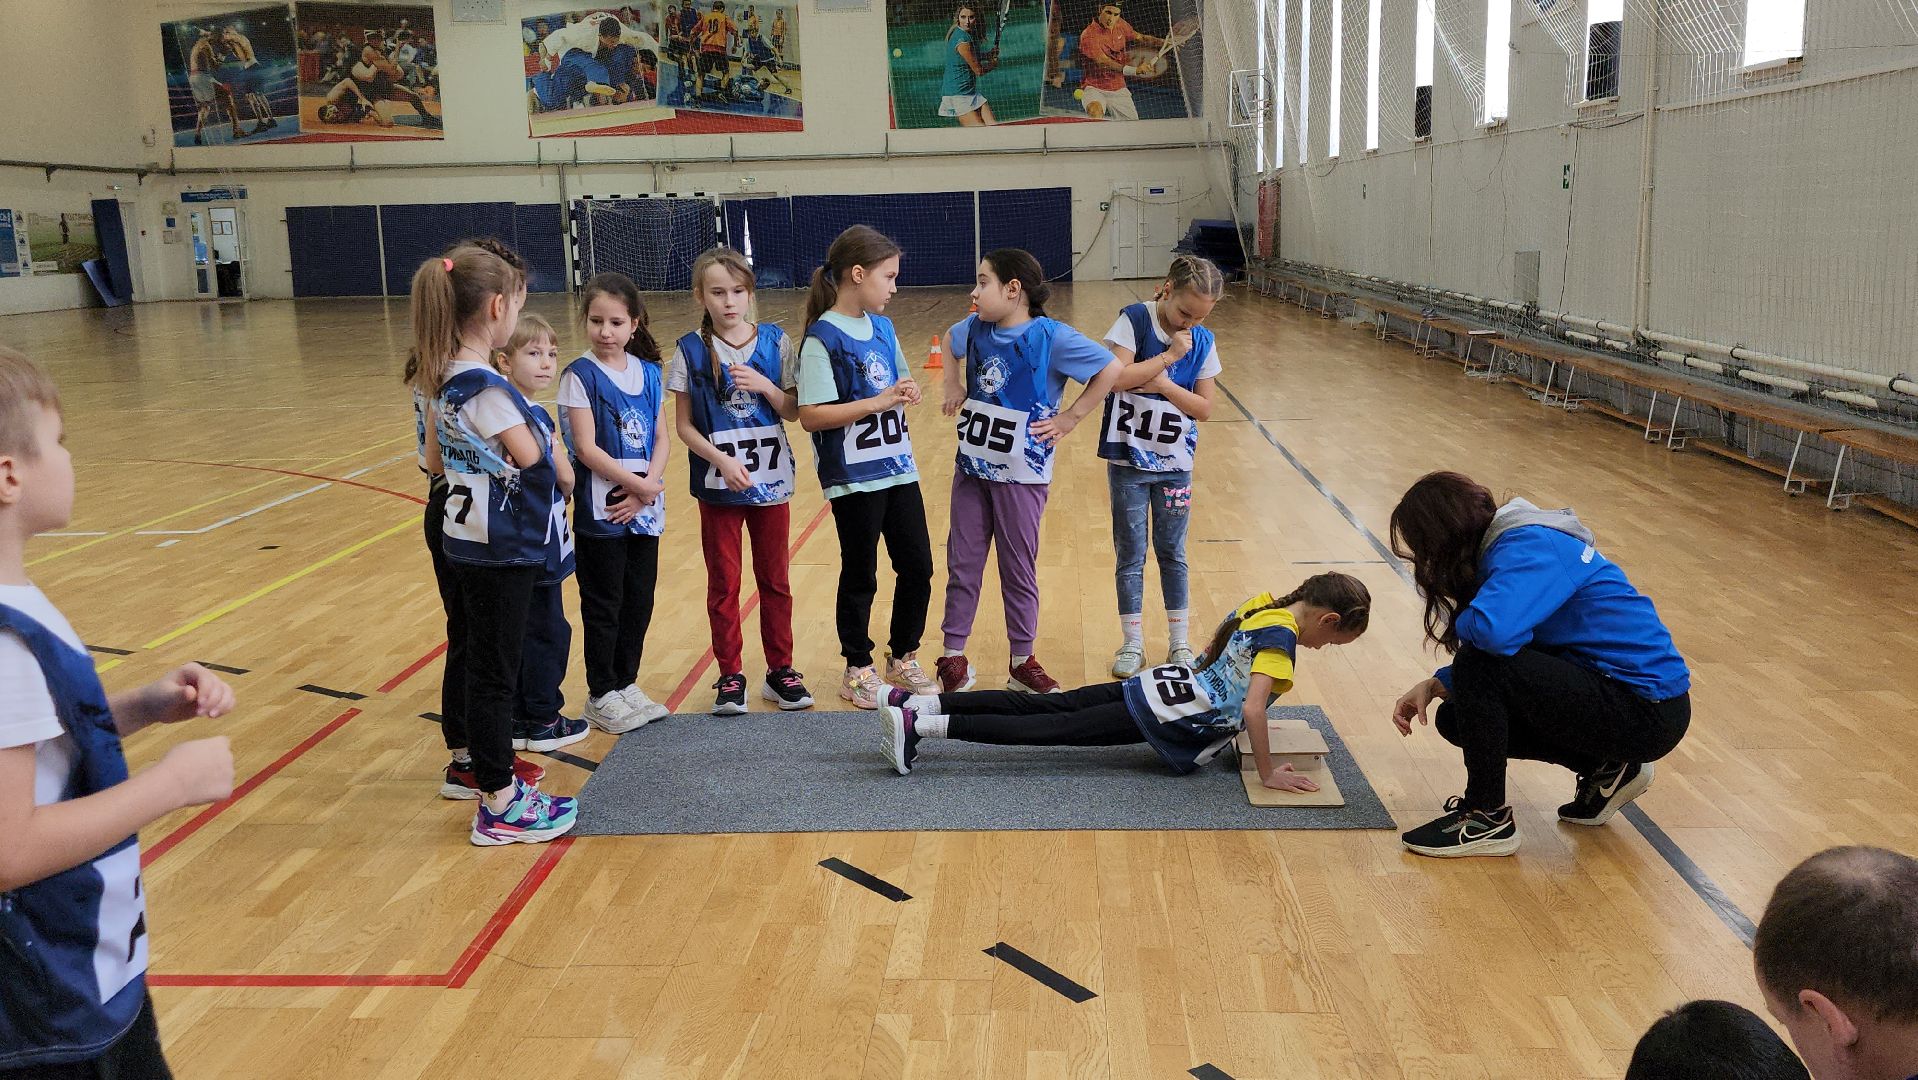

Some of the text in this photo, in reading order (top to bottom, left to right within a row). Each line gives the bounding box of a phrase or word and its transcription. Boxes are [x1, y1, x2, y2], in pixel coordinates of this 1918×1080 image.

[956, 408, 1017, 454] 205
[1116, 399, 1182, 444] 215
[444, 484, 473, 525] 7
